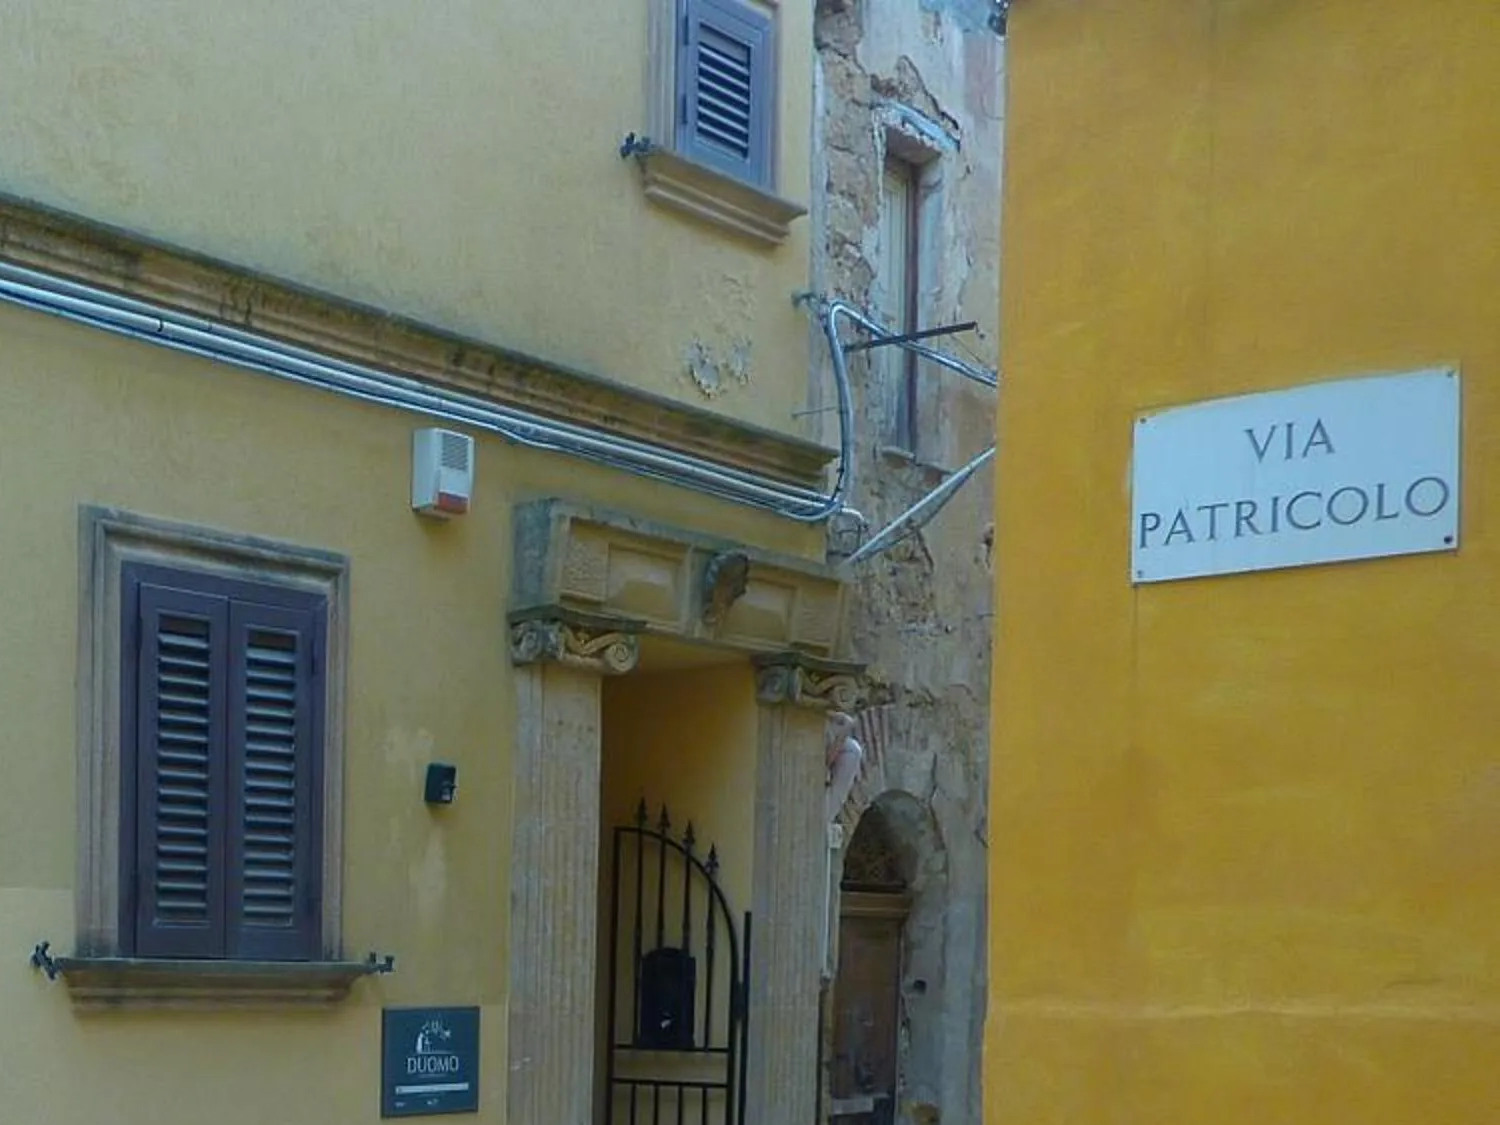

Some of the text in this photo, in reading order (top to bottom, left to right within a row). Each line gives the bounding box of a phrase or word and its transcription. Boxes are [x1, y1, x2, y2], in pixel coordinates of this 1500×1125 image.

[1244, 418, 1336, 463] VIA
[1138, 476, 1450, 549] PATRICOLO
[406, 1055, 460, 1074] DUOMO
